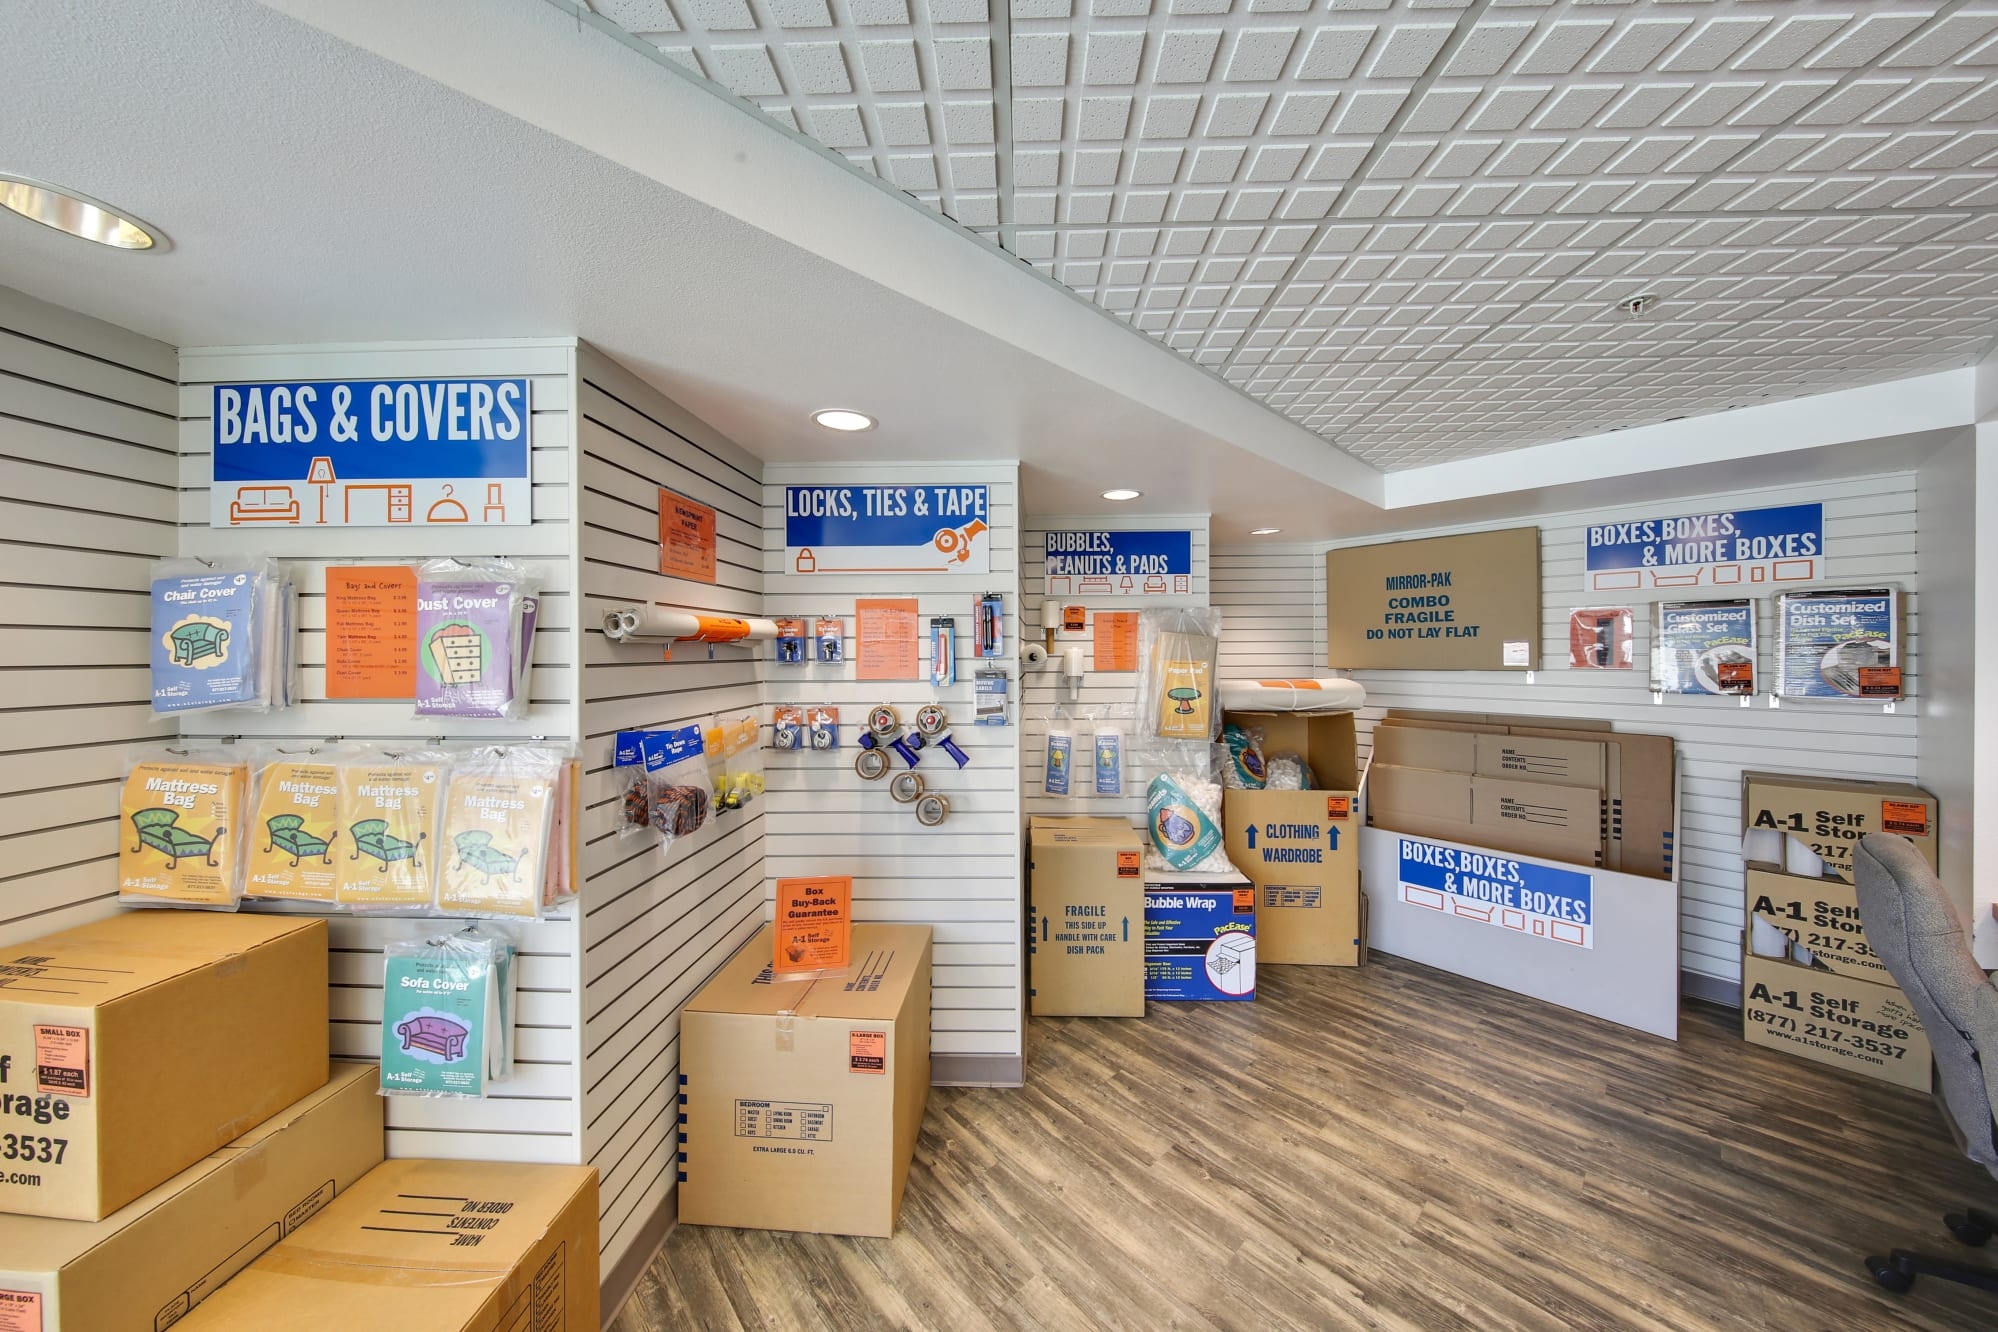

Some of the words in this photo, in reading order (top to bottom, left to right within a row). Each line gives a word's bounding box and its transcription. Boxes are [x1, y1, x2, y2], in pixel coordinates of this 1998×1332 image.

[219, 385, 318, 445] BAGS
[329, 384, 358, 443] &
[370, 382, 521, 443] COVERS
[787, 489, 858, 521] LOCKS,
[862, 489, 907, 516] TIES
[913, 489, 930, 516] &
[934, 488, 986, 516] TAPE
[1590, 521, 1661, 547] BOXES,
[1662, 513, 1741, 541] BOXES,
[1048, 532, 1114, 554] BUBBLES,
[1641, 546, 1658, 566] &
[1665, 540, 1728, 566] MORE
[1735, 532, 1817, 560] BOXES
[1047, 555, 1112, 575] PEANUTS
[1115, 555, 1127, 574] &
[1131, 554, 1168, 574] PADS
[346, 582, 361, 592] Bags
[364, 581, 376, 589] and
[379, 582, 402, 590] Covers
[1386, 571, 1452, 591] MIRROR-PAK
[164, 589, 197, 602] Chair
[200, 587, 236, 599] Cover
[1388, 594, 1450, 609] COMBO
[417, 598, 449, 611] Dust
[453, 596, 498, 610] Cover
[1790, 601, 1886, 614] Customized
[1385, 610, 1455, 624] FRAGILE
[1667, 610, 1747, 622] Customized
[1791, 615, 1826, 626] Dish
[1831, 615, 1857, 626] Set
[1366, 629, 1384, 640] DO
[1388, 628, 1414, 639] NOT
[1417, 627, 1441, 638] LAY
[1445, 625, 1480, 638] FLAT
[1706, 623, 1729, 632] Set
[146, 778, 218, 794] Mattress
[279, 781, 337, 795] Mattress
[358, 785, 419, 797] Mattress
[163, 792, 196, 809] Bag
[293, 793, 320, 807] Bag
[375, 796, 402, 809] Bag
[464, 795, 525, 810] Mattress
[480, 807, 507, 823] Bag
[1501, 804, 1525, 812] CONTENTS
[1754, 809, 1809, 833] A-1
[1816, 811, 1865, 827] Self
[1266, 824, 1320, 839] CLOTHING
[1263, 847, 1323, 863] WARDROBE
[1811, 843, 1853, 858] 217-
[1402, 840, 1459, 874] BOXES,
[1460, 852, 1525, 888] BOXES,
[805, 887, 824, 896] Box
[1444, 872, 1458, 894] &
[1462, 876, 1514, 907] MORE
[1520, 888, 1587, 923] BOXES
[792, 898, 836, 908] Buy-Back
[1144, 896, 1184, 909] Bubble
[1186, 897, 1217, 912] Wrap
[1753, 895, 1807, 922] A-1
[1814, 901, 1860, 920] Self
[788, 909, 839, 919] Guarantee
[1065, 905, 1106, 917] FRAGILE
[1065, 921, 1080, 929] THIS
[1081, 921, 1096, 929] SIDE
[1098, 921, 1107, 929] UP
[1214, 922, 1250, 935] PacEase
[792, 935, 806, 943] A-1
[1808, 933, 1879, 958] 217-3
[1067, 946, 1084, 954] DISH
[1086, 946, 1105, 954] PACK
[400, 976, 429, 989] Sofa
[433, 978, 469, 991] Cover
[1750, 983, 1803, 1012] A-1
[1810, 991, 1860, 1013] Self
[1810, 1005, 1909, 1040] Storage
[1907, 1014, 1920, 1023] hav
[40, 1028, 64, 1036] SMALL
[1747, 1008, 1796, 1032] (877)
[1804, 1023, 1908, 1060] 217-3537
[1766, 1027, 1884, 1066] www.a1storage.com
[387, 1072, 400, 1081] A-1
[288, 1206, 301, 1219] BED
[301, 1189, 323, 1208] ROOMS
[296, 1200, 320, 1220] MASTER
[477, 1201, 514, 1214] ORDER
[446, 1216, 500, 1230] CONTENTS
[450, 1233, 486, 1246] NAME
[17, 1295, 34, 1303] BOX
